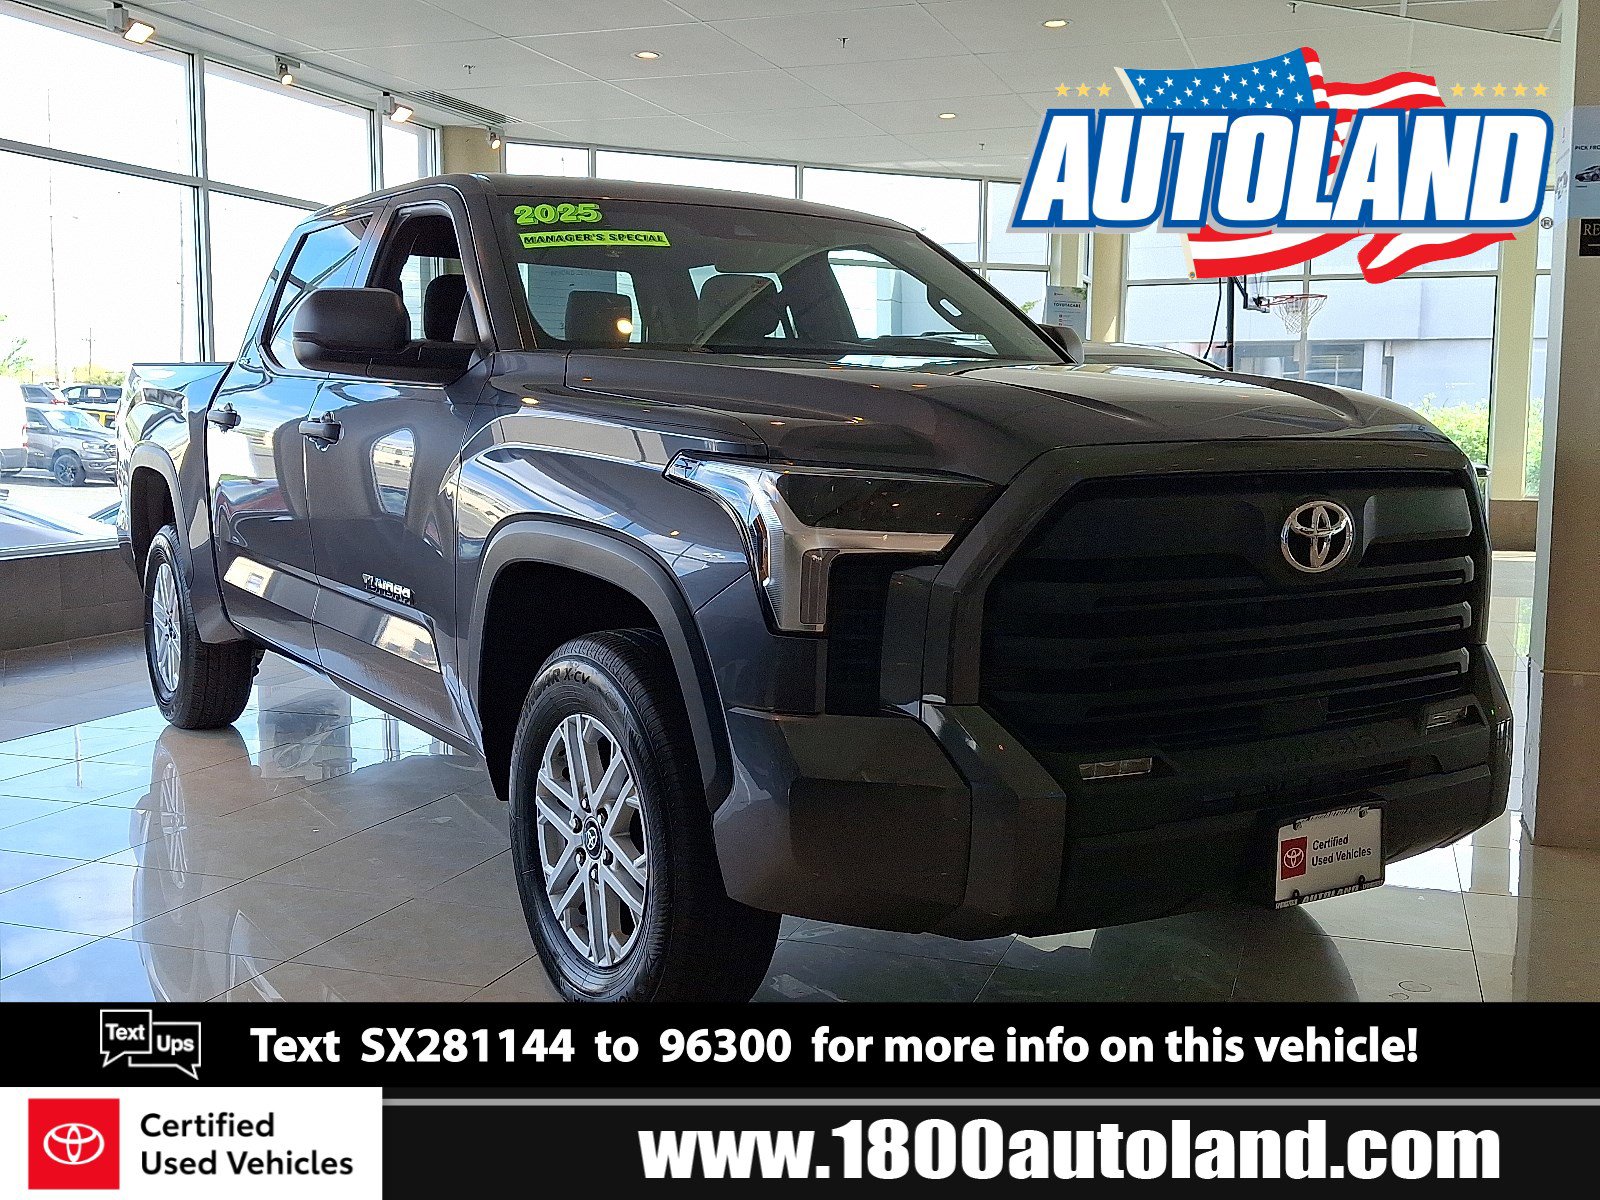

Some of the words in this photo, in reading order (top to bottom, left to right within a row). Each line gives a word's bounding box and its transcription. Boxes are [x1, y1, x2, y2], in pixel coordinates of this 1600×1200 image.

[514, 203, 602, 225] 2025
[523, 233, 604, 245] MANAGER'S
[608, 233, 665, 243] SPECIAL
[1312, 834, 1349, 850] Certified
[1311, 853, 1334, 866] Used
[1336, 847, 1372, 862] Vehicles
